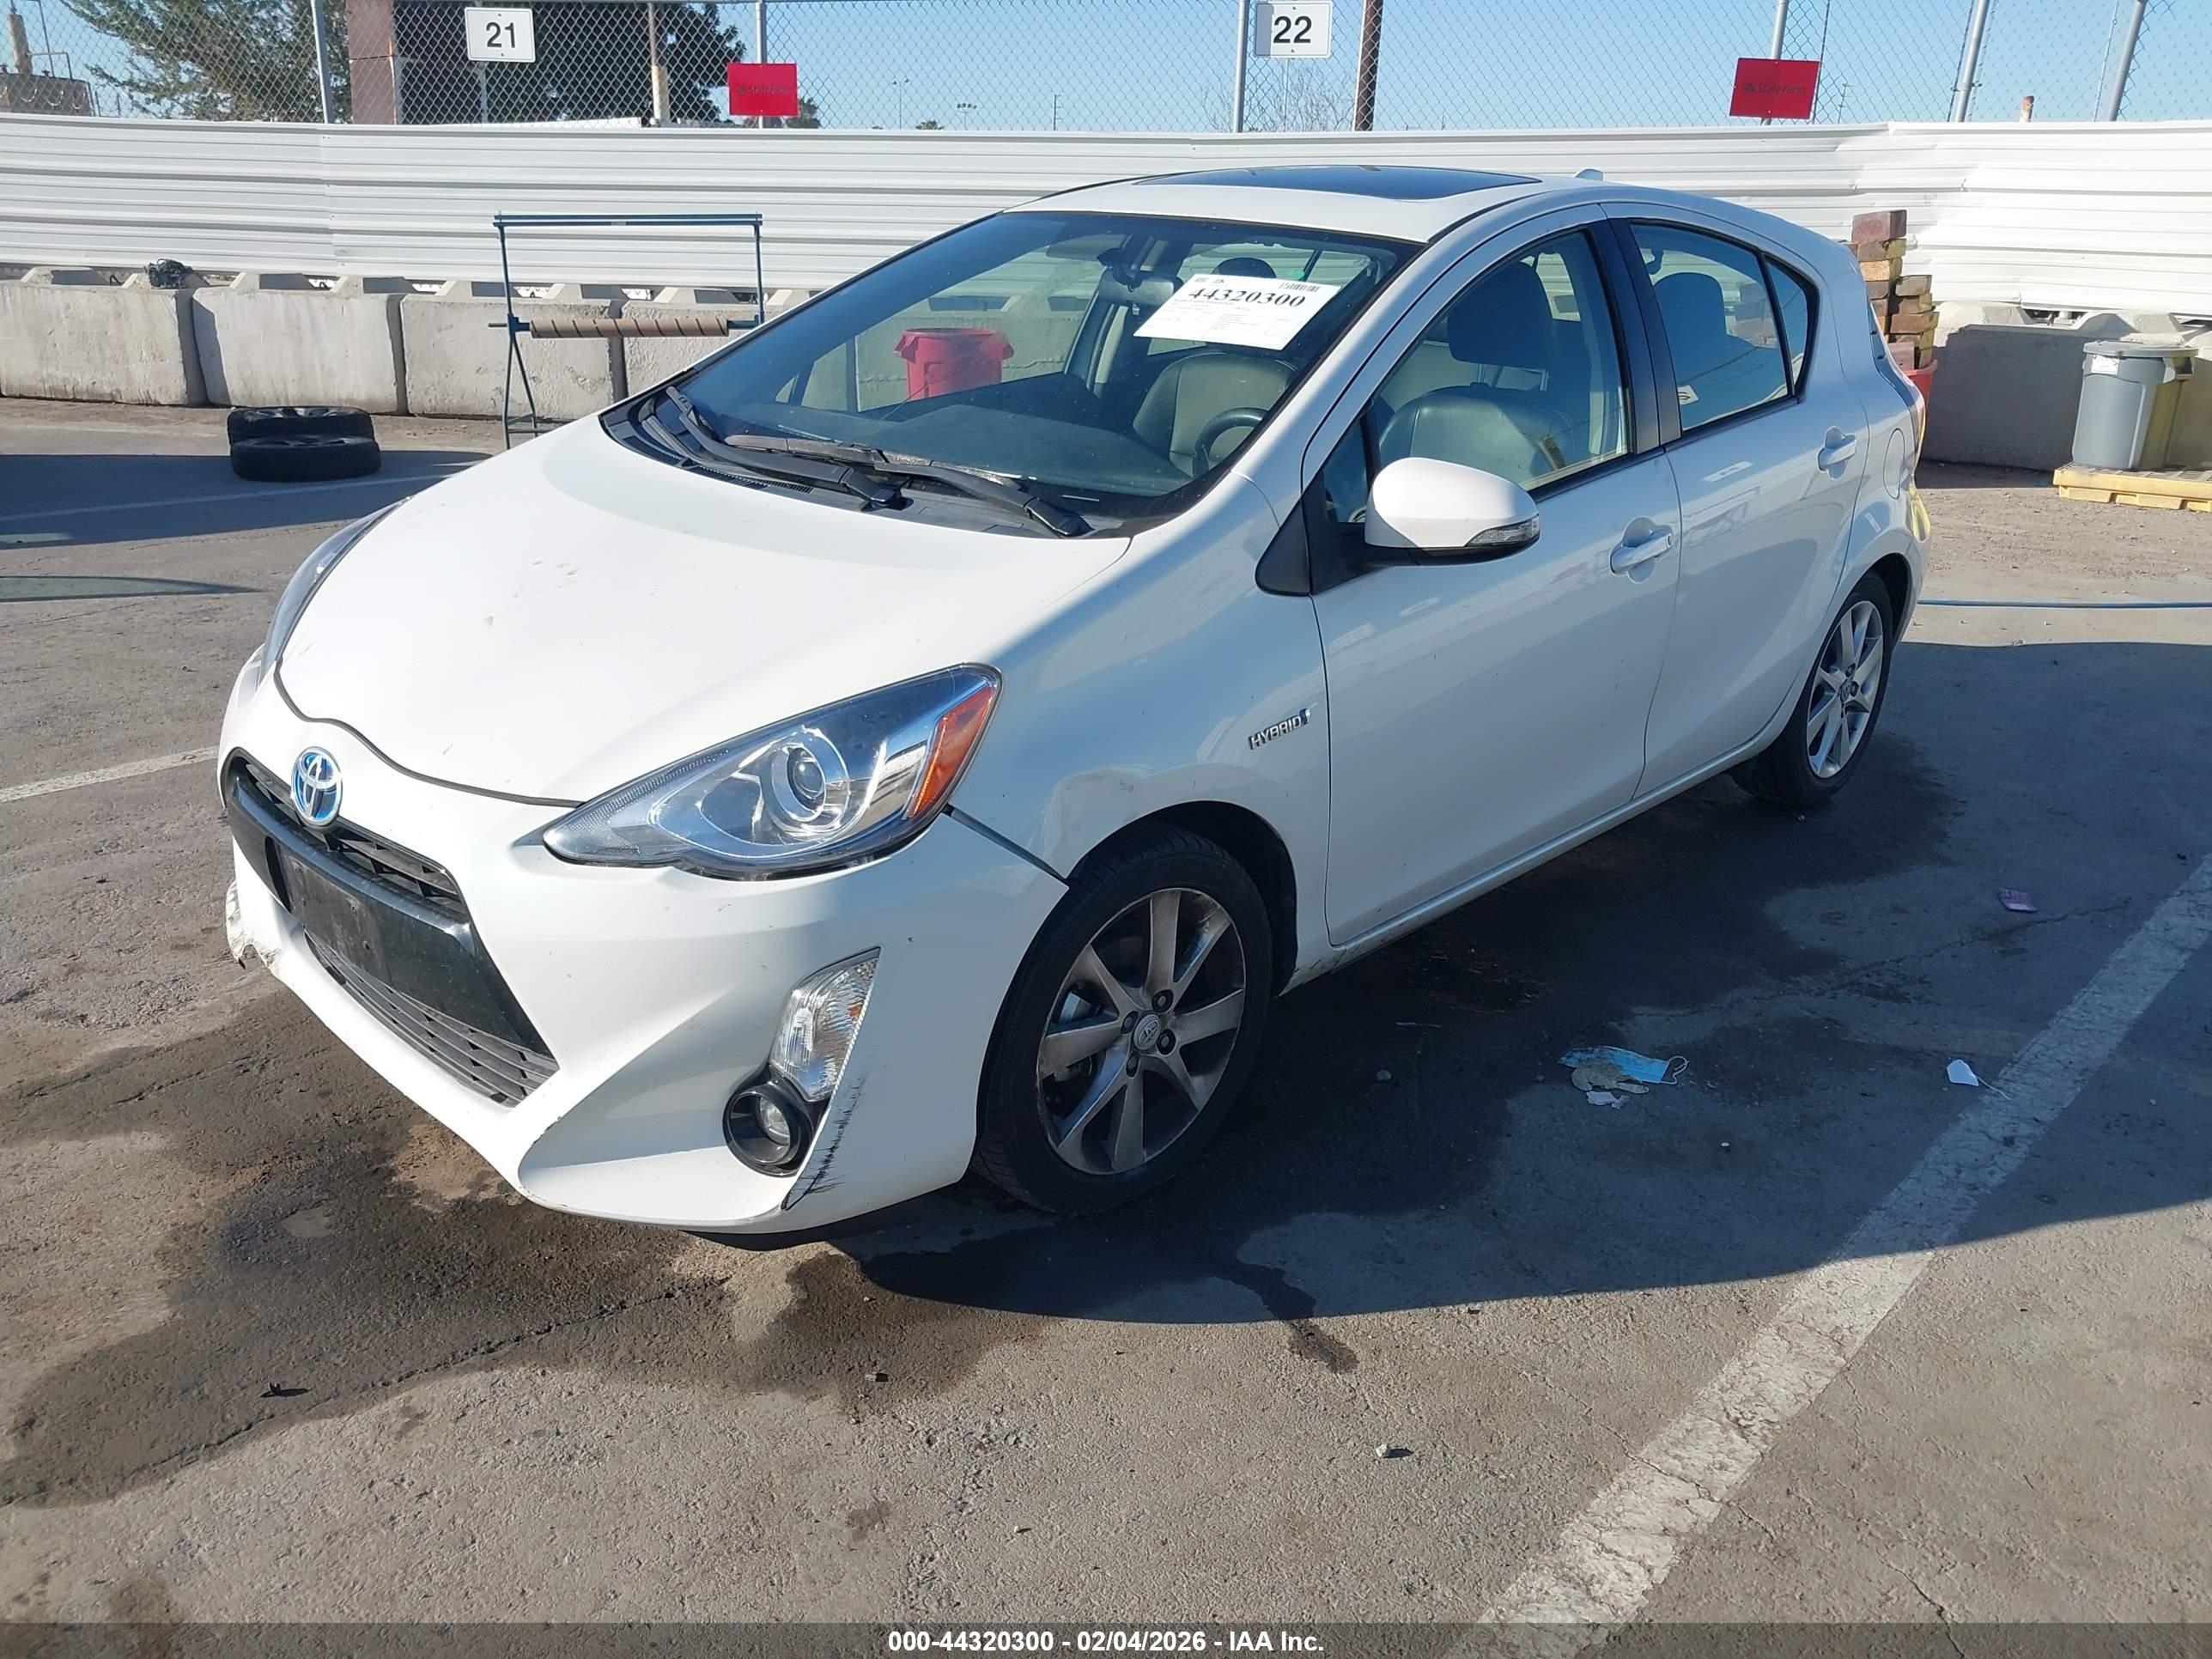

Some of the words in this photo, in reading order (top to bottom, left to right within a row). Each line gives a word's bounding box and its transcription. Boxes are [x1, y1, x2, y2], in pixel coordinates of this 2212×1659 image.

[485, 21, 516, 48] 21
[1273, 15, 1312, 44] 22
[1188, 287, 1306, 307] 44320300
[1248, 714, 1302, 750] HYBRID
